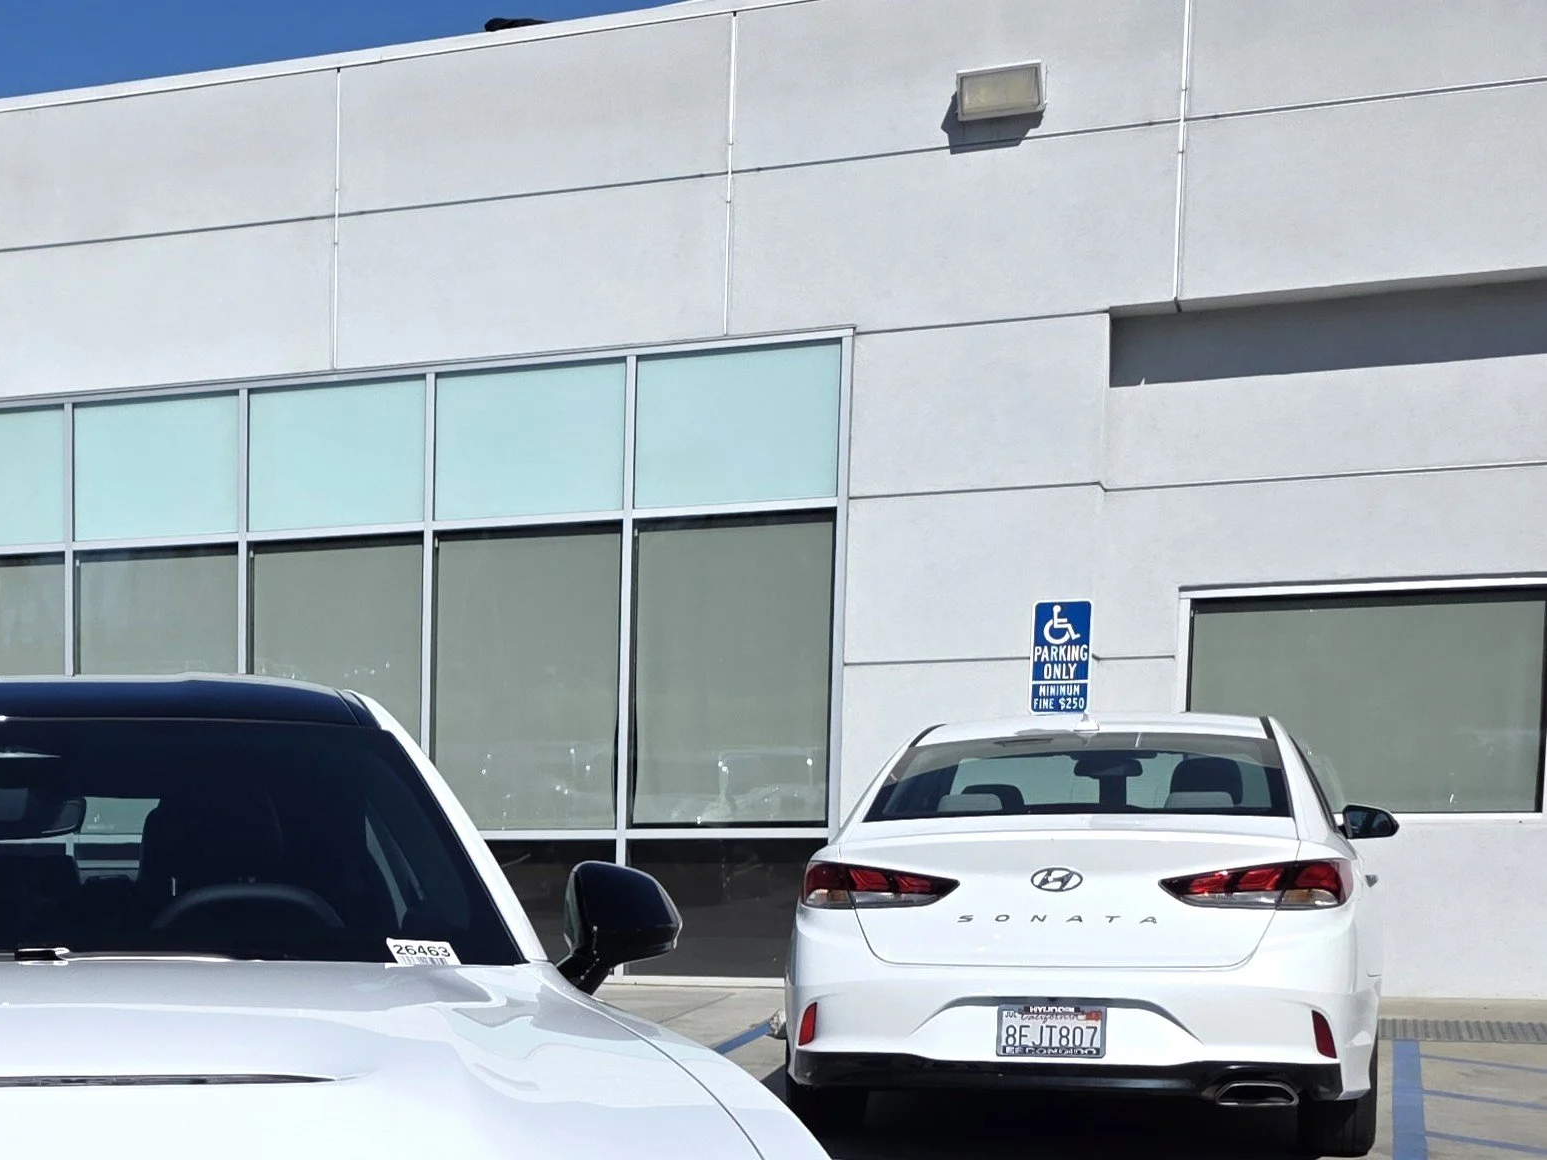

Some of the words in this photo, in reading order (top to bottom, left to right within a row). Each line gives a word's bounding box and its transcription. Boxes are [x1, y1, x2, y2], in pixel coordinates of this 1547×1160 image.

[1034, 644, 1088, 662] PARKING
[1044, 663, 1077, 679] ONLY
[1039, 684, 1080, 696] MINIMUM
[1033, 698, 1054, 709] FINE
[1059, 697, 1084, 710] $250
[957, 914, 1158, 924] SONATA
[393, 944, 451, 957] 26463
[1005, 1025, 1098, 1047] 8EJT807
